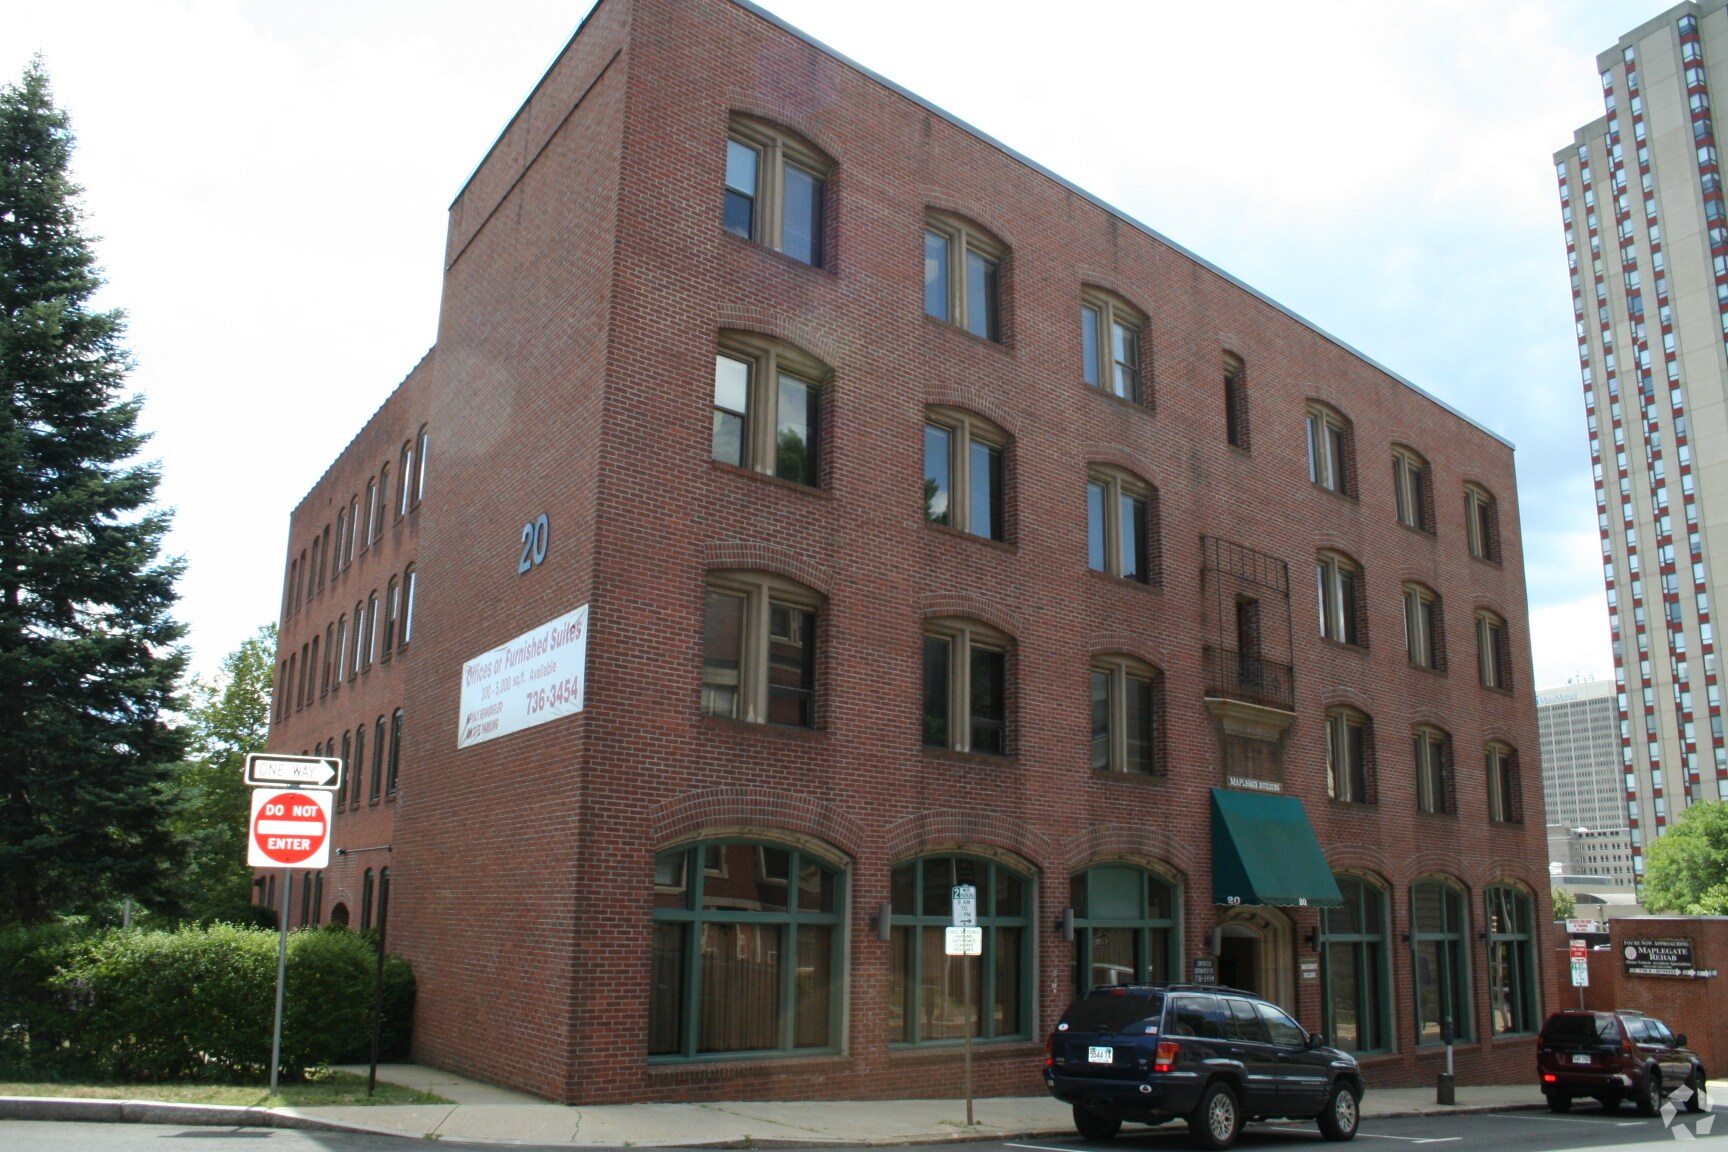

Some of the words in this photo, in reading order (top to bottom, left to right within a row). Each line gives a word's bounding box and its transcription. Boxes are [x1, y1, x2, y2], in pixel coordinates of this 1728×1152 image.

[518, 513, 548, 575] 20
[466, 663, 492, 687] Offices
[493, 657, 503, 673] or
[505, 631, 549, 670] Furnished
[550, 621, 582, 651] Suites
[481, 684, 491, 701] 300
[495, 676, 511, 696] 5,000
[529, 660, 557, 681] Available
[526, 676, 578, 715] 736-3454
[260, 762, 284, 777] ONE
[293, 764, 316, 778] WAY
[265, 804, 285, 816] DO
[292, 805, 318, 817] NOT
[267, 837, 311, 851] ENTER
[954, 888, 960, 899] 2
[1227, 896, 1241, 905] 20
[1638, 946, 1688, 955] MAPLEGATE
[1649, 953, 1677, 961] REHAB
[1090, 1050, 1104, 1059] 5544
